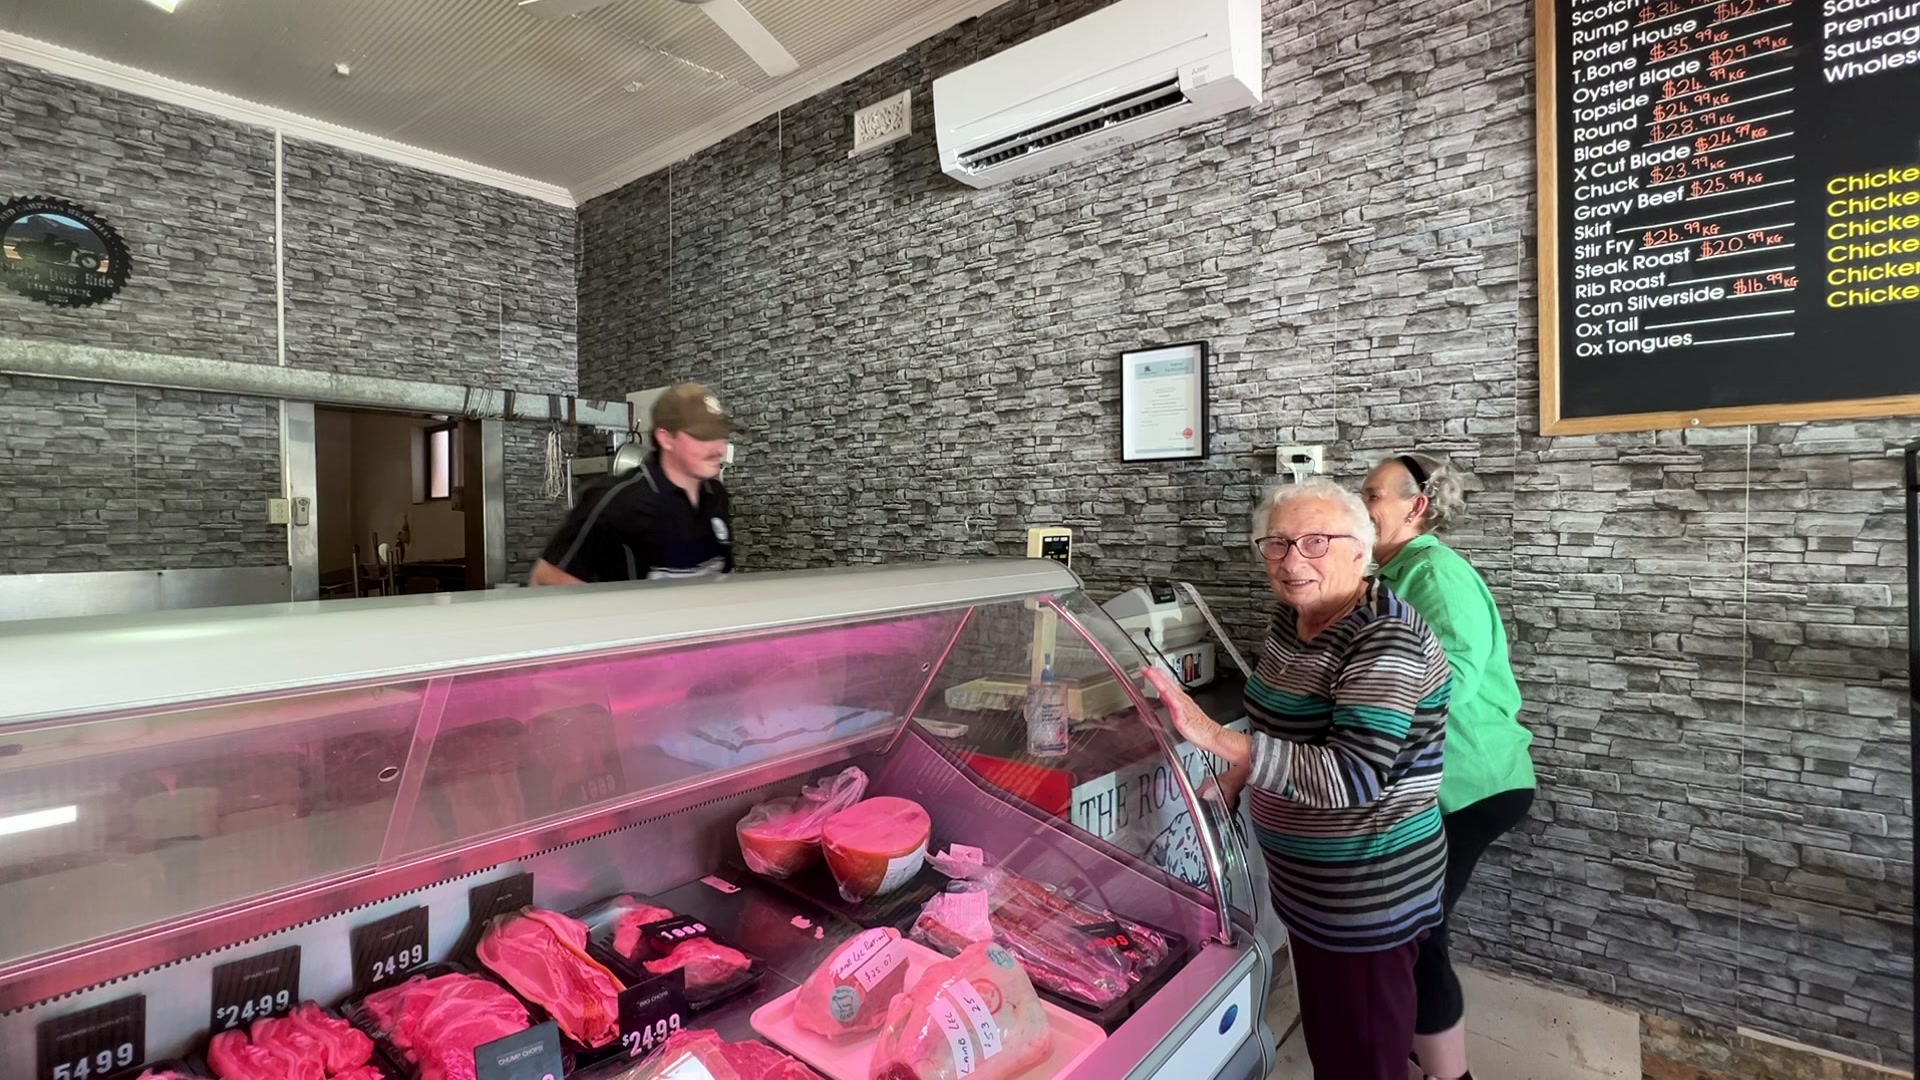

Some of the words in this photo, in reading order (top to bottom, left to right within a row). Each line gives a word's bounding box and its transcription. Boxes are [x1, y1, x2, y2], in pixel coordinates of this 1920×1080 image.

[1572, 19, 1629, 46] Rump
[1572, 38, 1628, 65] Porter
[1633, 20, 1697, 48] House
[1572, 57, 1637, 84] T.Bone
[1823, 50, 1920, 83] Wholes
[1573, 77, 1635, 103] Oyster
[1639, 60, 1700, 86] Blade
[1572, 94, 1649, 123] Topside
[1574, 114, 1637, 143] Round
[1574, 139, 1630, 163] Blade
[1574, 165, 1587, 182] X
[1591, 157, 1626, 178] Cut
[1630, 145, 1691, 170] Blade
[1574, 175, 1639, 201] Chuck
[1827, 168, 1920, 195] Chicke
[1574, 199, 1633, 221] Gravy
[1637, 185, 1685, 209] Beef
[1827, 191, 1920, 217] Chicke
[1574, 220, 1612, 241] Skirt
[1827, 214, 1920, 240] Chicke
[1574, 244, 1602, 260] Stir
[1605, 239, 1635, 255] Fry
[1827, 238, 1920, 263] Chicke
[1574, 258, 1629, 280] Steak
[1632, 247, 1691, 270] Roast
[1575, 282, 1606, 299] Rib
[1610, 271, 1666, 294] Roast
[1827, 284, 1920, 309] Chicke
[1575, 301, 1623, 318] Corn
[1627, 286, 1725, 311] Silverside
[1575, 323, 1602, 338] Ox
[1606, 316, 1638, 334] Tail
[1575, 342, 1602, 357] Ox
[1606, 333, 1693, 354] Tongues
[1079, 780, 1129, 840] THE
